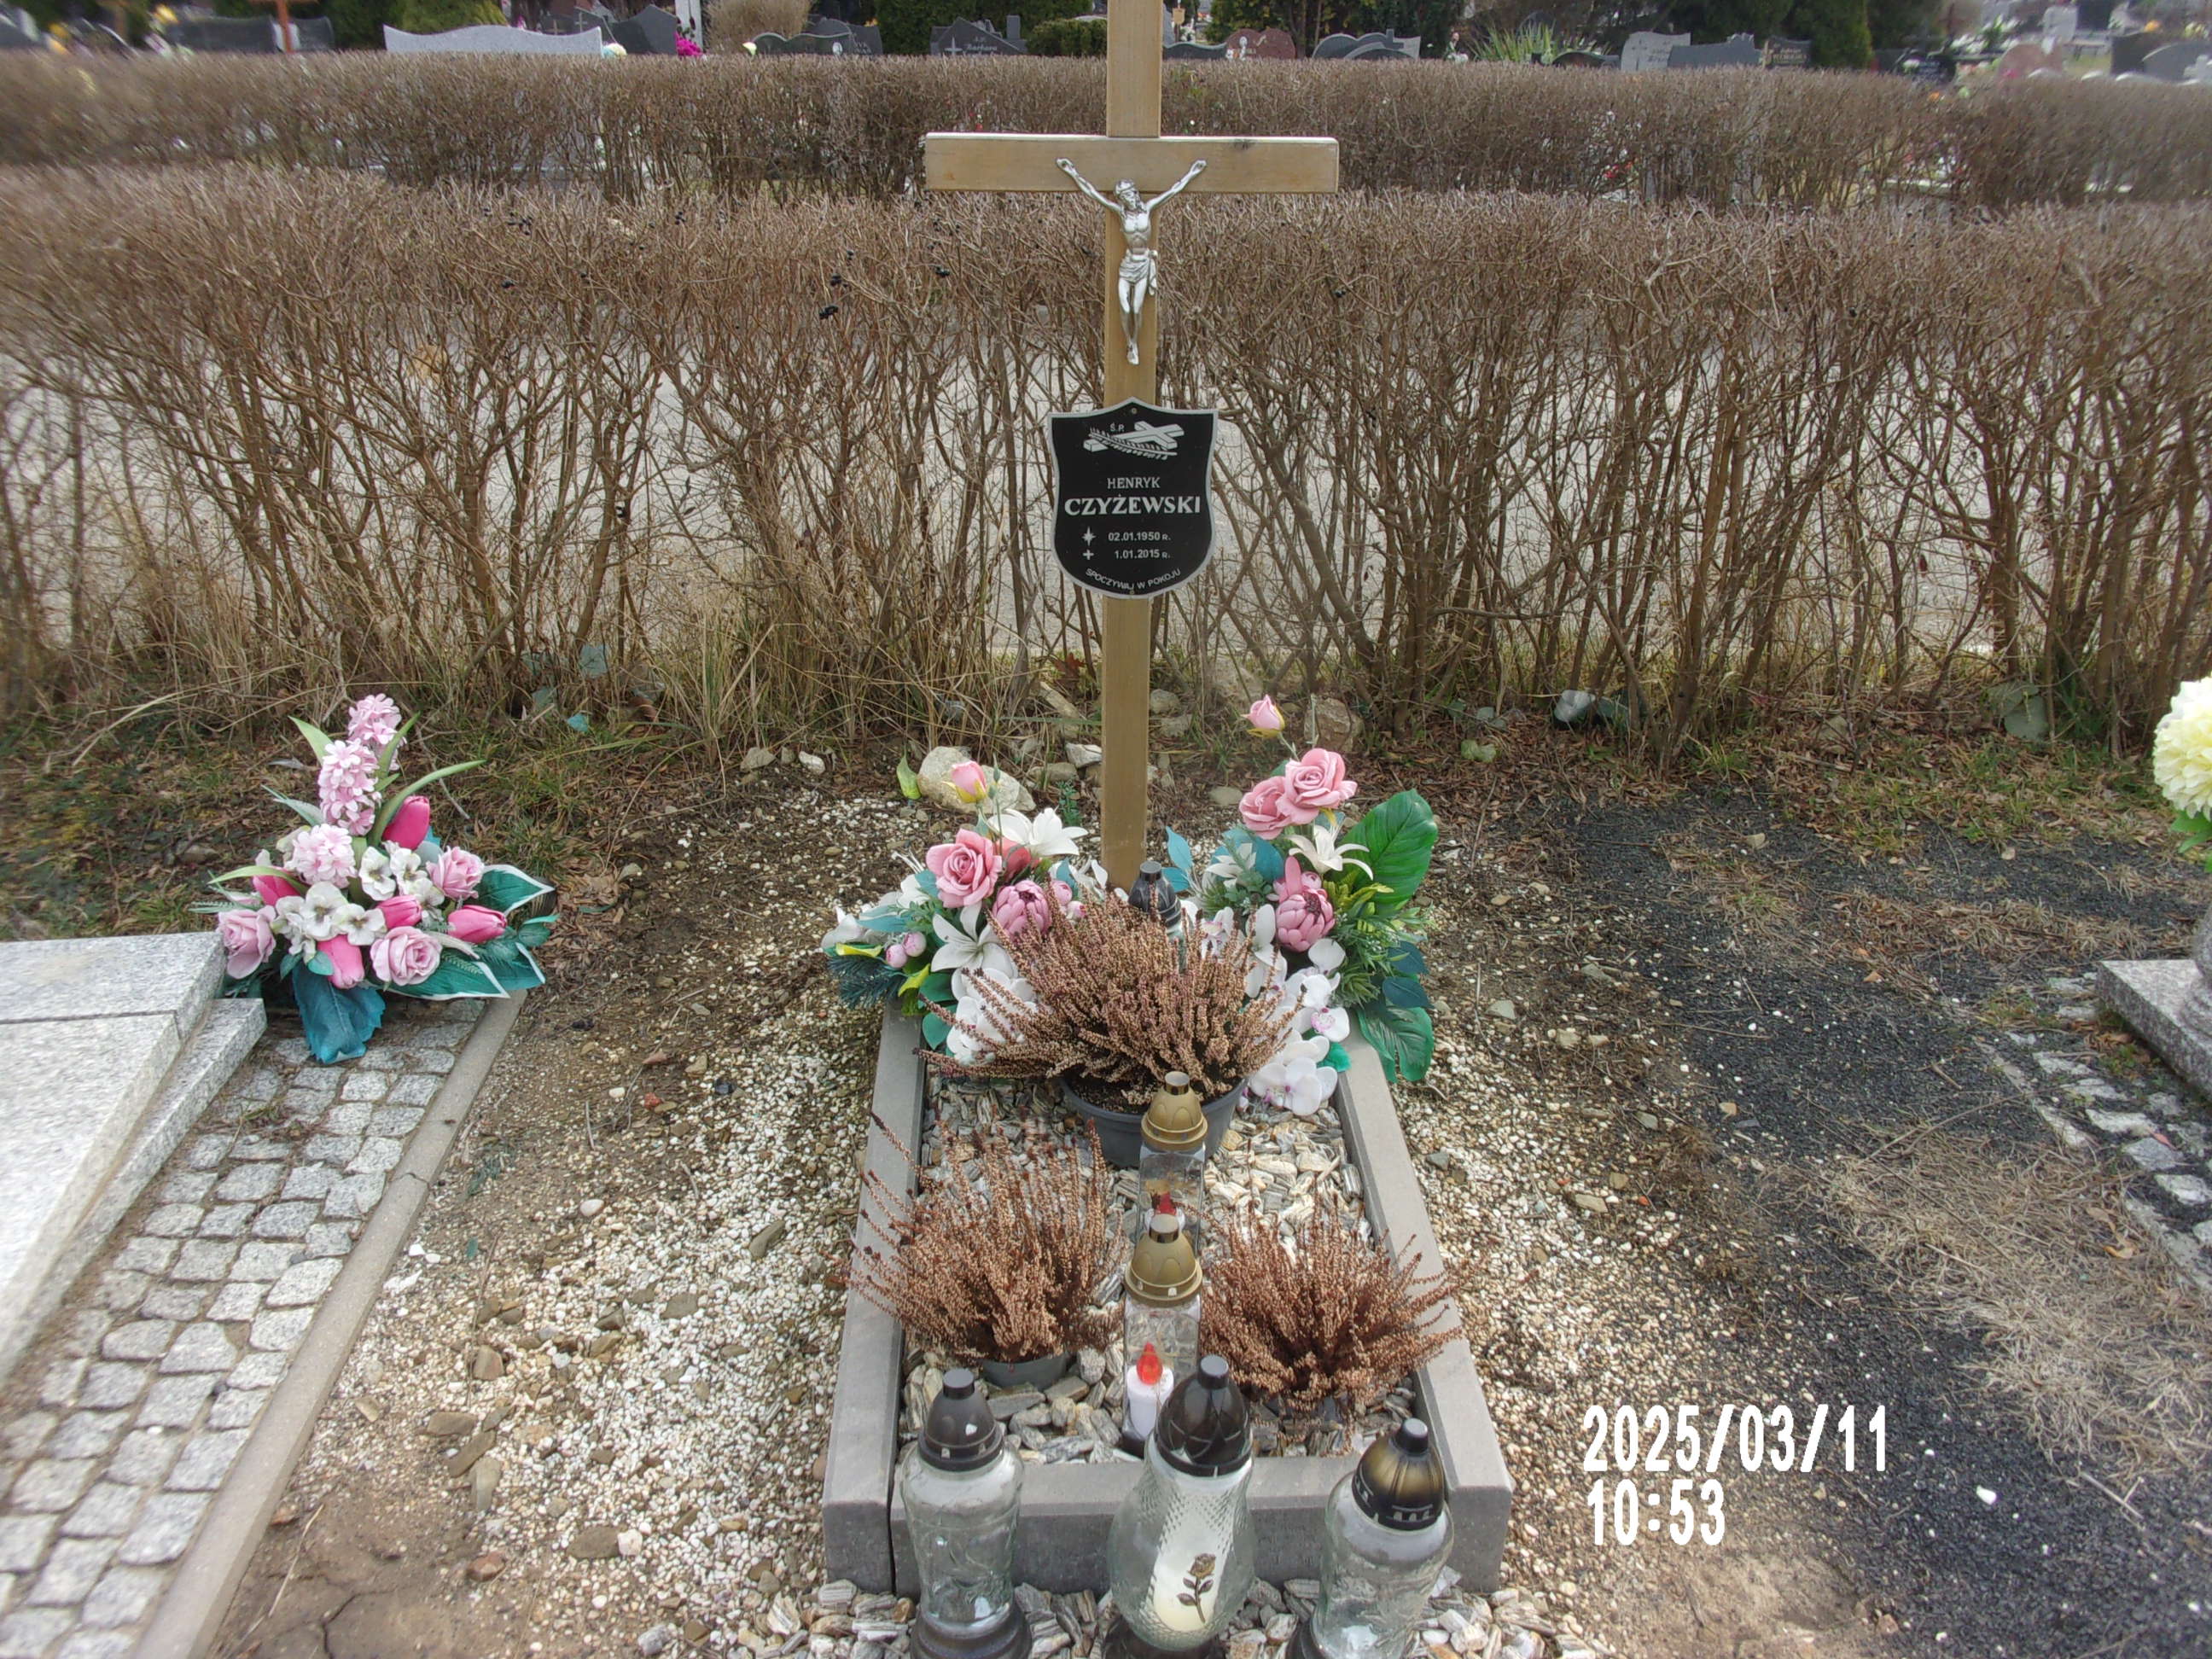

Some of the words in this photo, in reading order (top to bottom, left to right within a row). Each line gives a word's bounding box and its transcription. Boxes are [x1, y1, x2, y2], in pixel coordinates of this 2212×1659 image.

[1107, 476, 1161, 489] HENRYK
[1064, 495, 1201, 515] CZYŻEWSKI
[1108, 532, 1161, 541] 02.01.1950
[1114, 549, 1161, 559] 1.01.2015
[1086, 568, 1134, 590] SPOCZYWAJ
[1137, 580, 1146, 589] W
[1148, 568, 1181, 586] POKOJU
